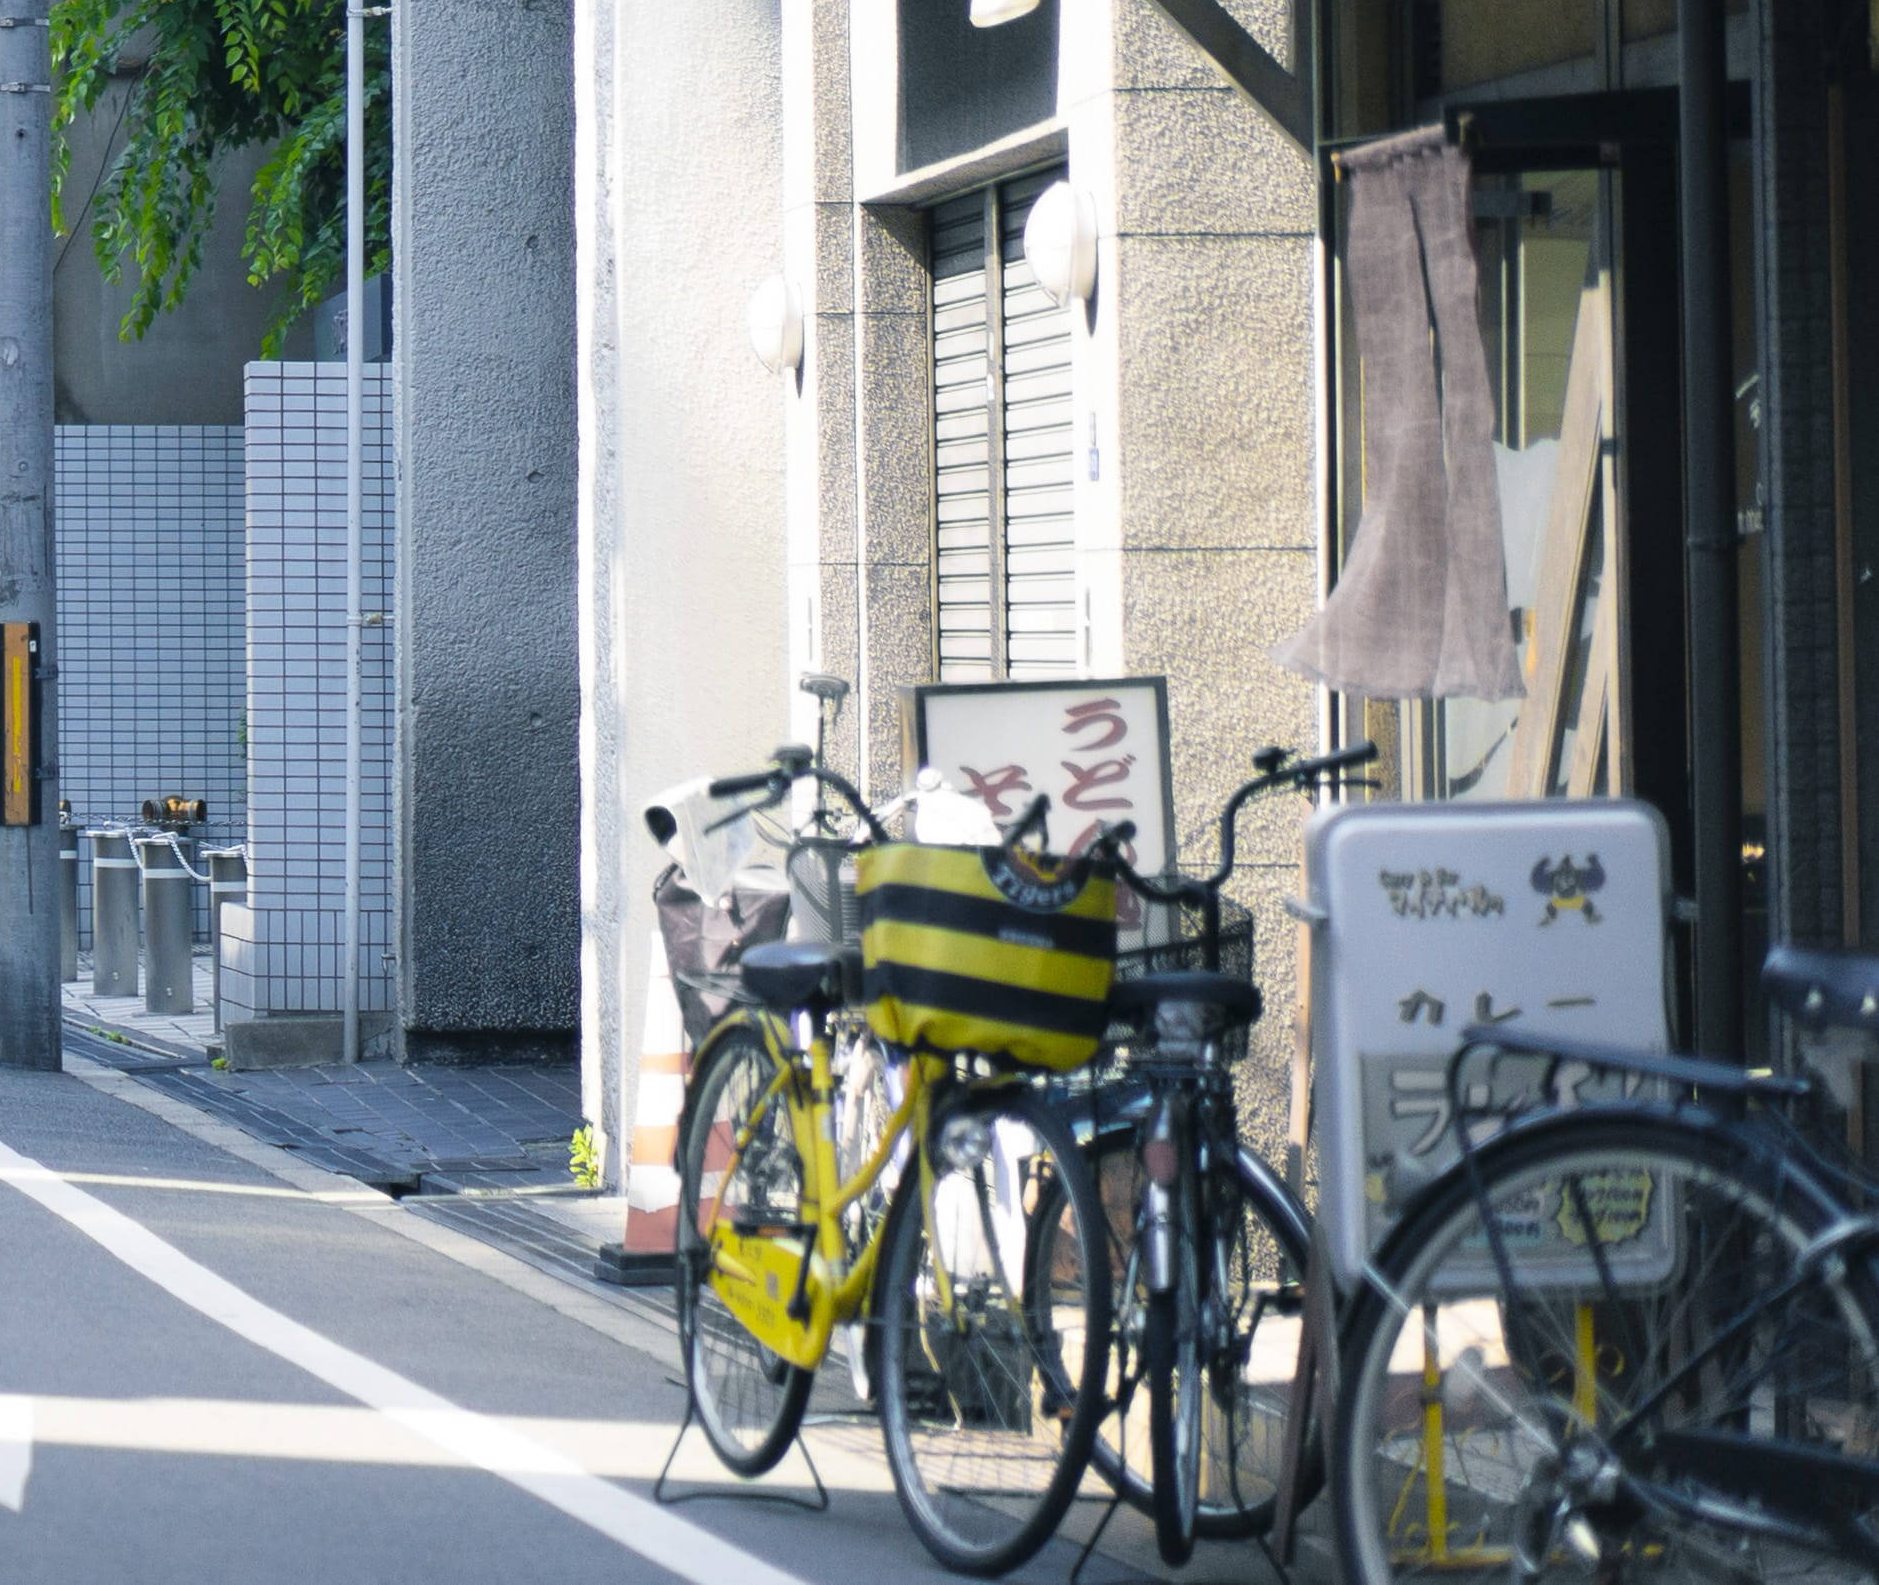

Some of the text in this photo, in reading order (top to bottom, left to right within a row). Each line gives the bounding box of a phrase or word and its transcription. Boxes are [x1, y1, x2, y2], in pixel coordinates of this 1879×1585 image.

[994, 862, 1076, 906] Tigers
[1397, 987, 1597, 1027] カレー
